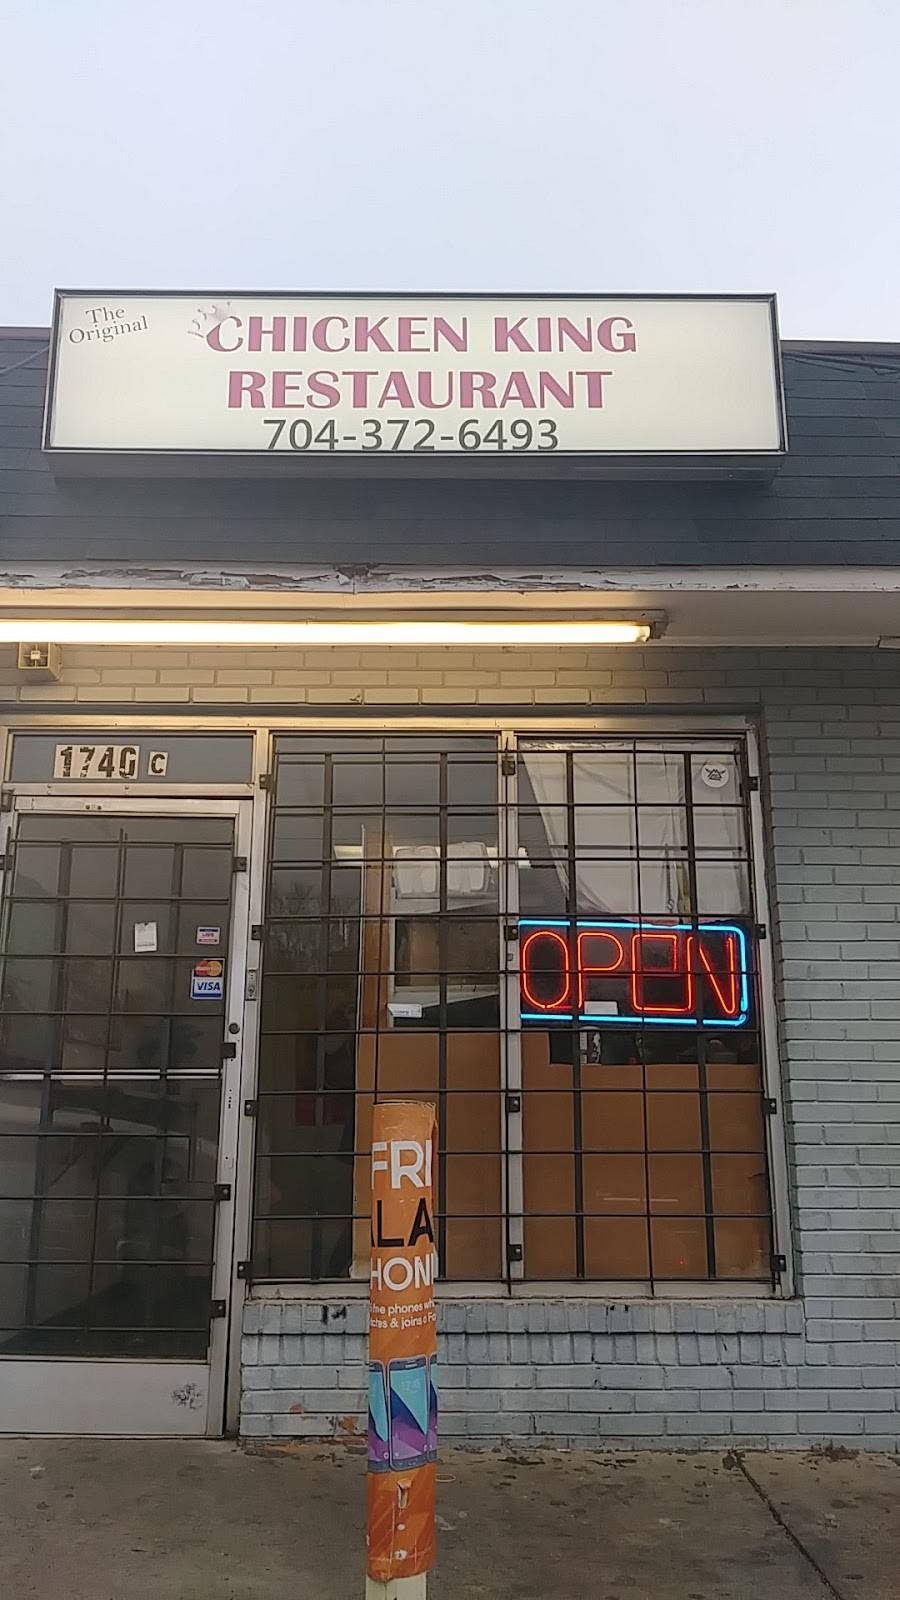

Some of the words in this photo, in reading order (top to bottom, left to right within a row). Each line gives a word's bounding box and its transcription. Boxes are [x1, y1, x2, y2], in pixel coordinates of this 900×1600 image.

[69, 315, 149, 344] Original
[84, 306, 126, 324] The
[206, 315, 468, 353] CHICKEN
[493, 315, 637, 353] KING
[227, 370, 614, 410] RESTAURANT
[262, 418, 559, 451] 704-372-6493
[60, 746, 138, 779] 1740
[150, 753, 166, 774] C
[197, 981, 221, 991] VISA
[520, 929, 738, 1015] OPEN
[370, 1197, 434, 1248] LA
[387, 1303, 423, 1317] phones
[390, 1317, 399, 1329] &
[401, 1315, 422, 1330] joins
